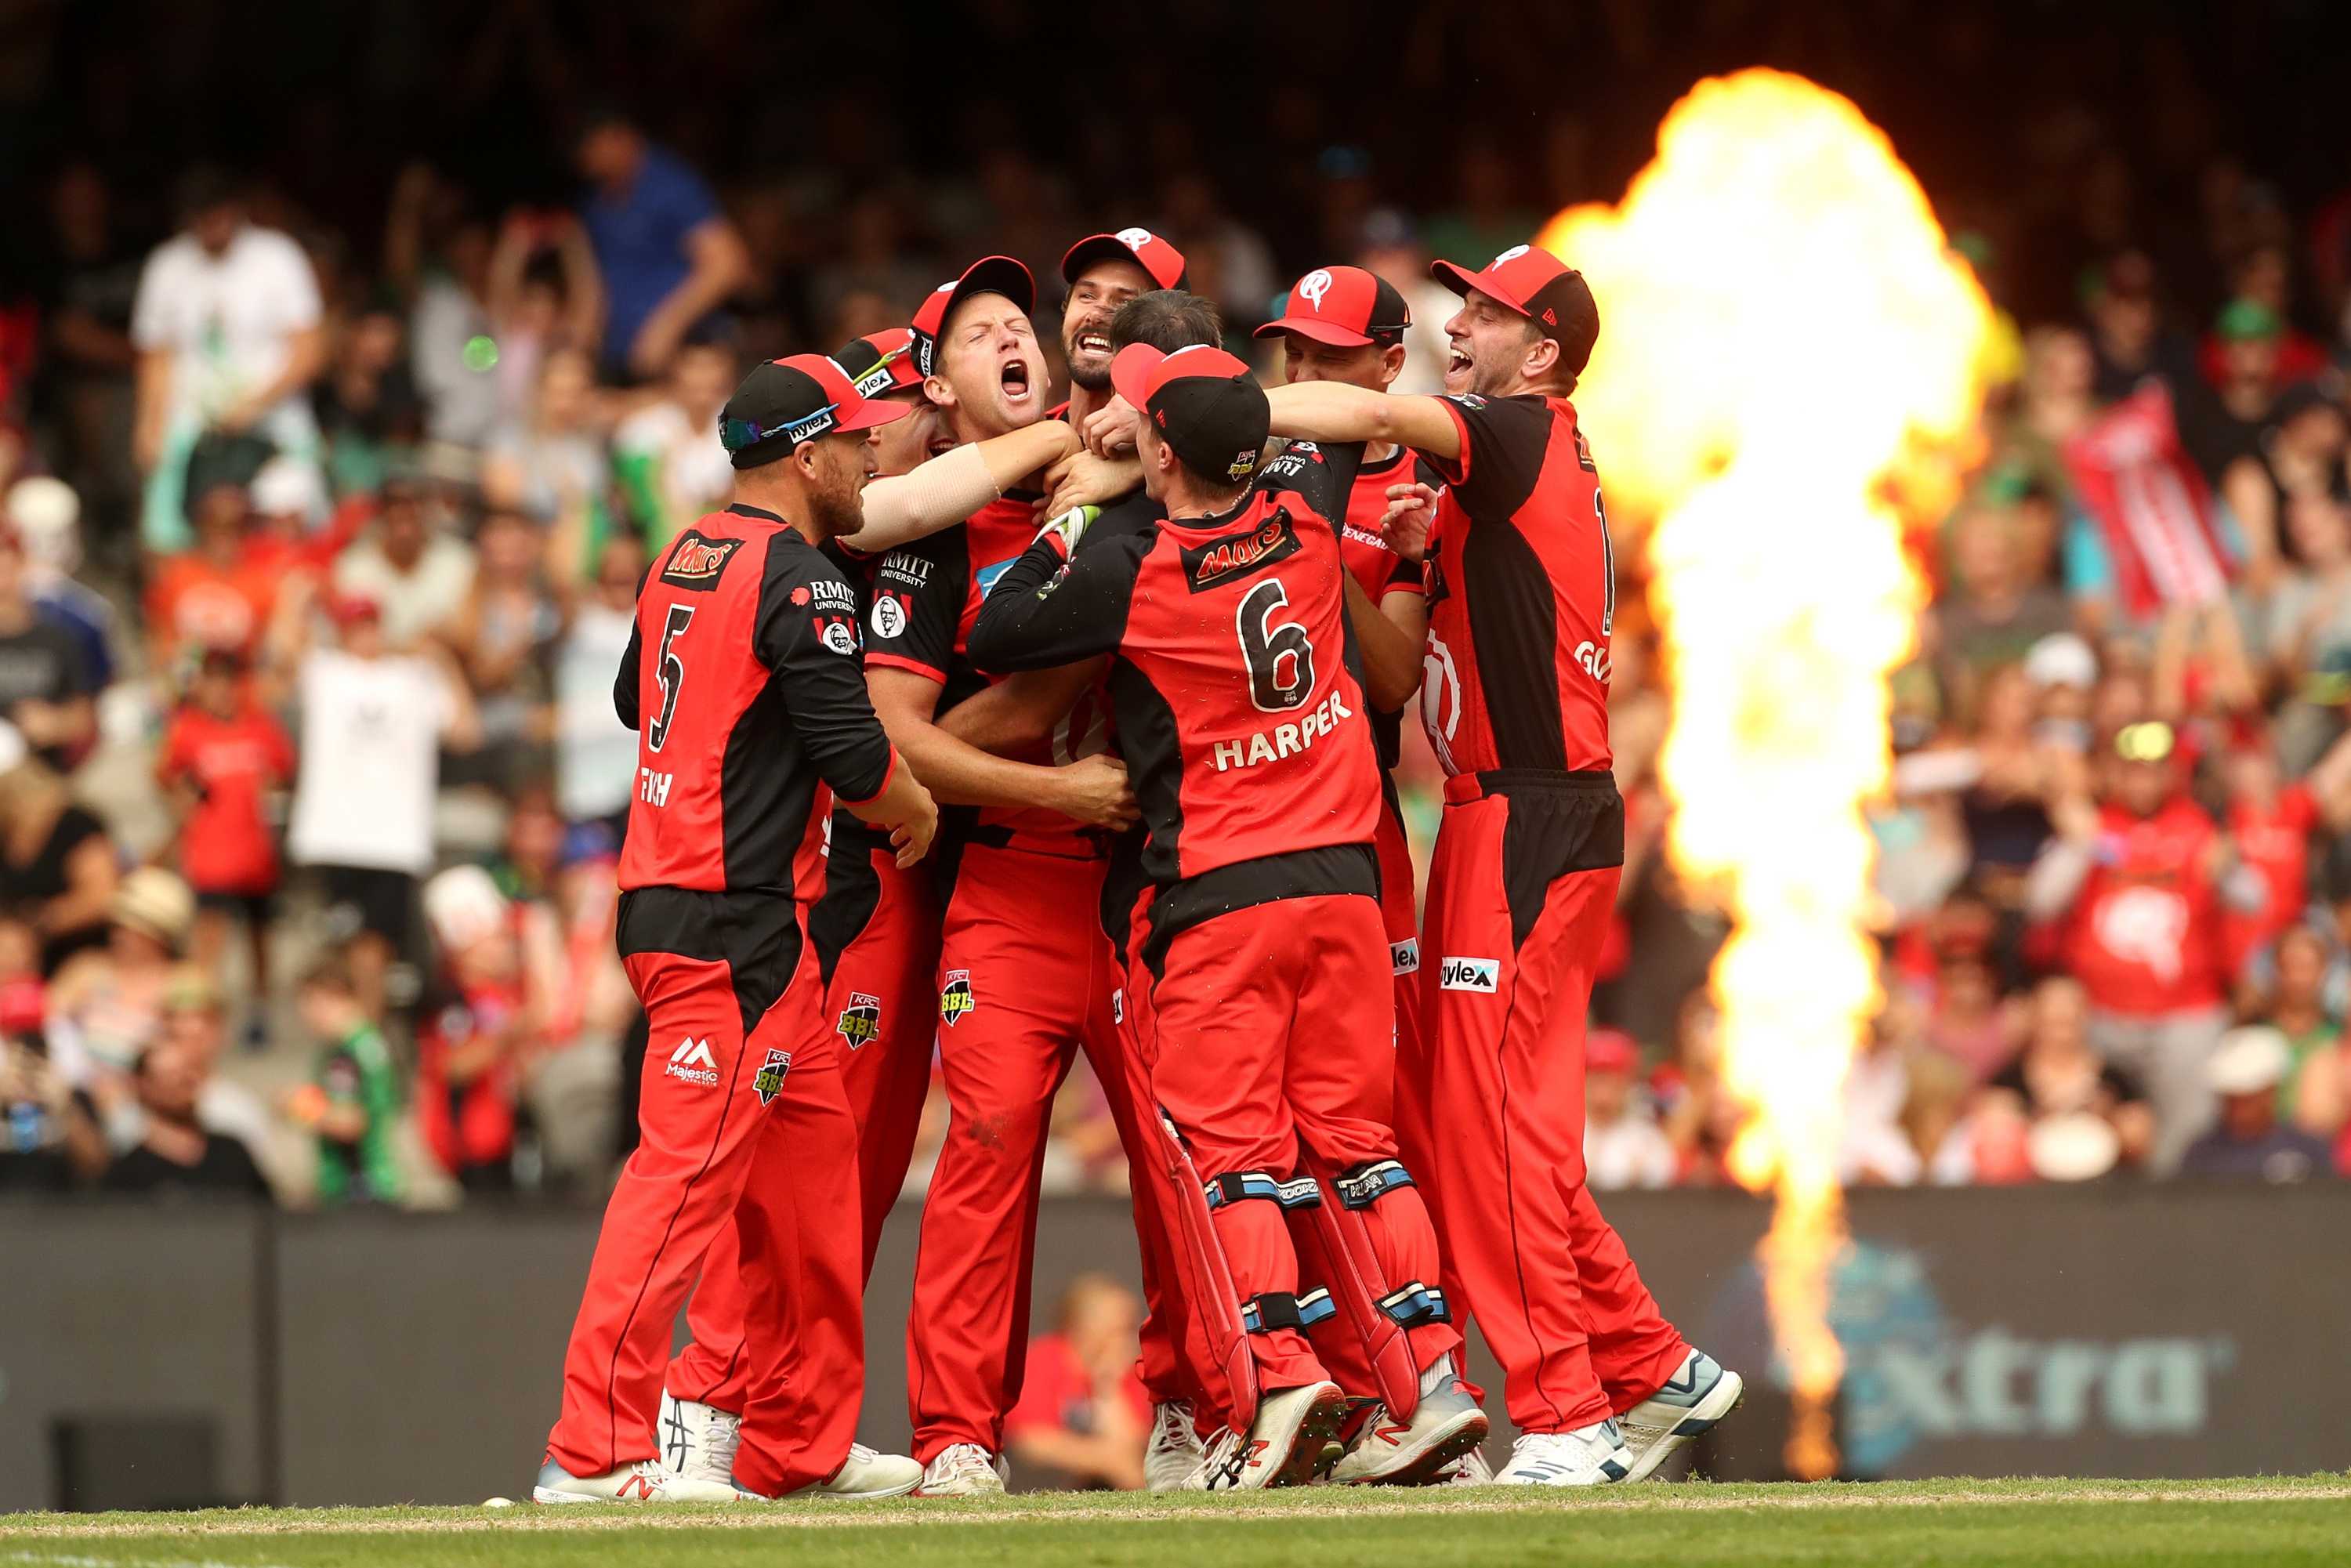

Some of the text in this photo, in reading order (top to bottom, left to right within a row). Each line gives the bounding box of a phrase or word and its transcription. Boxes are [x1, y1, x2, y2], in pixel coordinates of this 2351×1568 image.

[858, 371, 889, 397] ylex
[667, 538, 733, 573] Mars
[1197, 516, 1284, 579] Mars
[882, 551, 934, 579] RMIT
[881, 569, 926, 588] UNIVERSITY
[1236, 578, 1315, 713] 6
[649, 603, 696, 753] 5
[1215, 690, 1353, 772] HARPER
[1390, 945, 1417, 969] lex
[1441, 961, 1495, 987] nylex
[855, 995, 878, 1006] KFC
[941, 992, 973, 1012] BBL
[839, 1015, 877, 1038] BBL
[770, 1052, 789, 1063] KFC
[665, 1063, 718, 1081] Majestic
[1865, 1330, 2206, 1436] xtra
